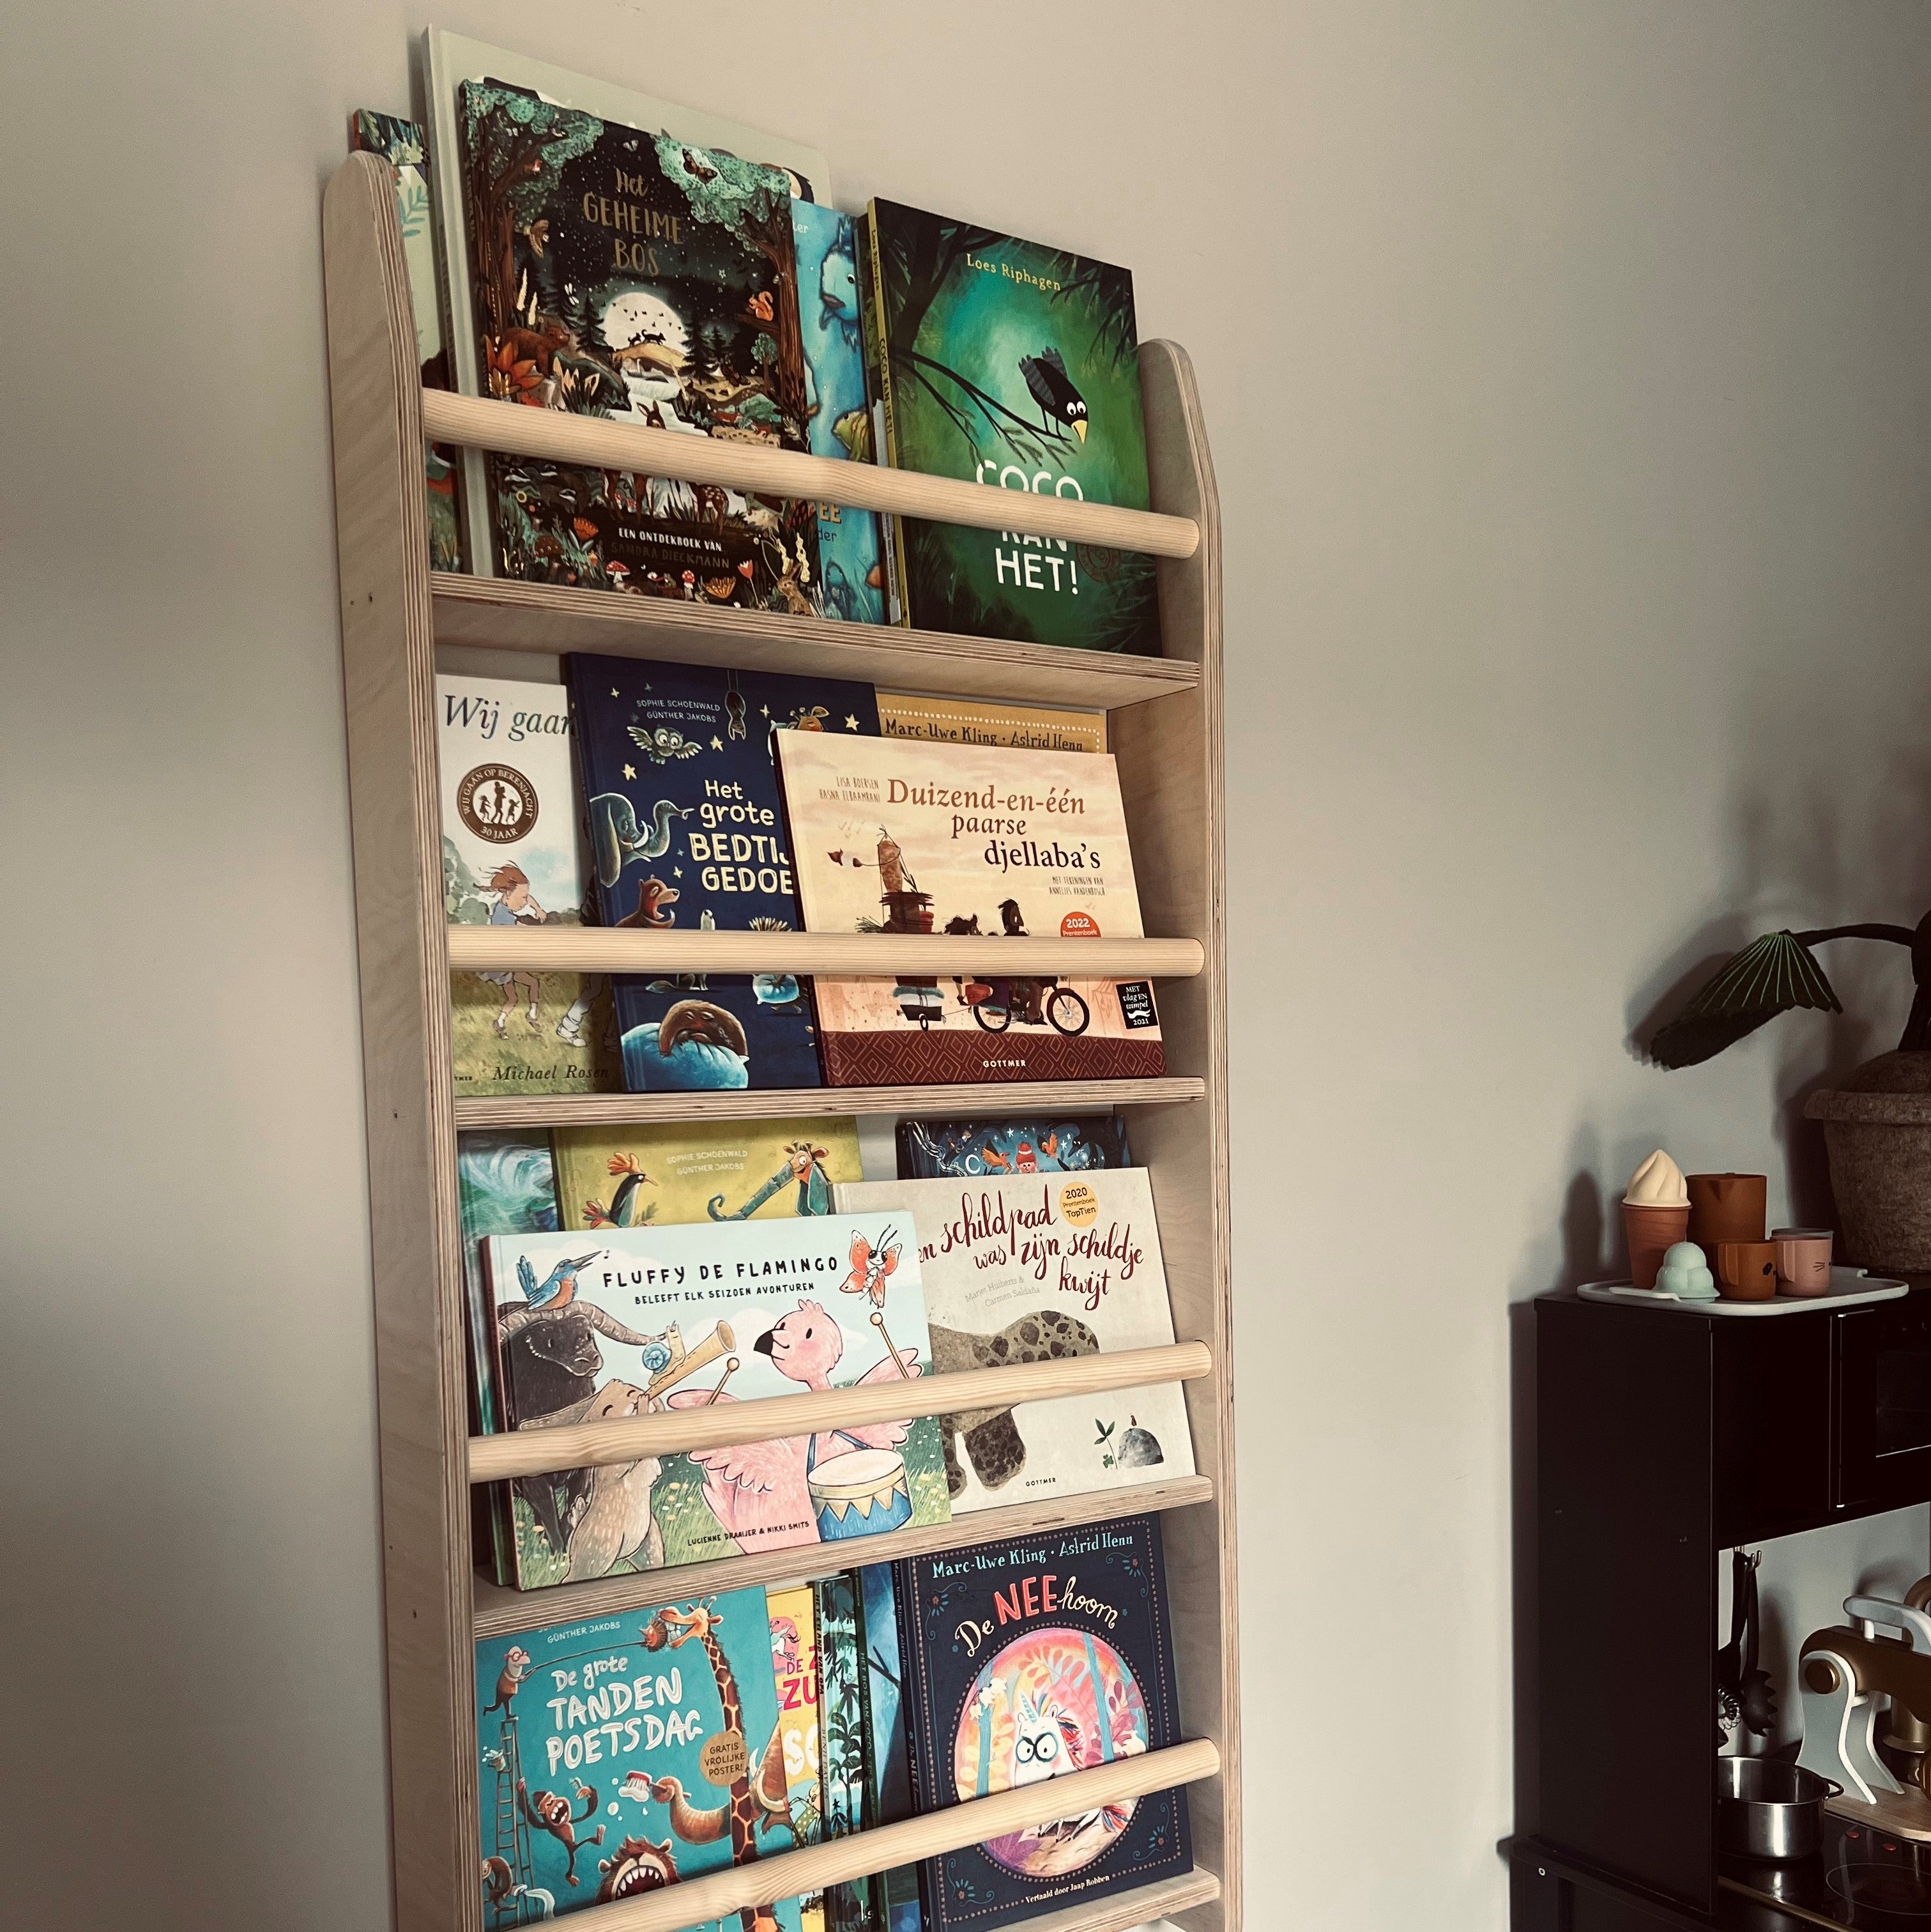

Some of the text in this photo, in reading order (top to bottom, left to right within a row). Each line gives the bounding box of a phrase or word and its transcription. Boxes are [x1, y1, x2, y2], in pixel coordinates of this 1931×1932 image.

[614, 167, 649, 197] Het
[583, 191, 685, 245] GEHEIME
[614, 238, 660, 276] BOS
[966, 253, 1061, 291] Loes Riphagen
[880, 338, 888, 373] COCO
[618, 527, 722, 552] EEN ONTDEKBOEK VAN
[611, 542, 729, 569] SANDRA DIECKMANN
[995, 548, 1079, 595] HET!
[445, 694, 500, 739] Wij
[667, 700, 721, 712] SCHOENWALD
[686, 712, 716, 723] JAKOBS
[885, 717, 957, 740] Marc-Uwe
[961, 726, 997, 746] Kling
[1011, 730, 1050, 749] Astrid
[464, 772, 484, 796] GAAN
[484, 768, 496, 778] OP
[498, 769, 534, 819] BERENJACHT
[705, 779, 744, 800] Het
[836, 776, 851, 787] LISA
[887, 779, 1085, 815] Duizend-en-één
[700, 801, 775, 829] grote
[950, 814, 1027, 839] paarse
[480, 826, 519, 839] 30 JAAR
[984, 839, 1101, 873] djellaba's
[701, 866, 793, 894] GEDOE
[1065, 917, 1090, 928] 2022
[492, 1064, 608, 1080] Michael Rosen
[982, 1059, 1026, 1068] GOTTMER
[666, 1150, 748, 1164] SOPHIE SCHOENWALD
[715, 1163, 744, 1171] JAKOBS
[1065, 1187, 1088, 1199] 2020
[940, 1184, 1058, 1255] schildpad
[1066, 1207, 1096, 1218] TopTien
[973, 1222, 1143, 1280] was zijn schildje
[603, 1257, 837, 1287] FLUFFY DE FLAMINGO
[1058, 1255, 1112, 1311] kwijt
[635, 1283, 814, 1305] BELEEFT ELK SEIZOEN AVONTUREN
[985, 1292, 1012, 1307] Carmen
[1026, 1477, 1056, 1487] GOTTMER
[687, 1535, 721, 1546] LUCIENNE
[767, 1525, 786, 1533] NIKKI
[788, 1521, 809, 1529] SMITS
[932, 1532, 1133, 1579] Marc-Uwe Kling Astrid Henn
[589, 1621, 621, 1633] JAKOBS
[955, 1620, 994, 1657] De
[551, 1655, 628, 1692] De grote
[786, 1659, 804, 1675] DE
[547, 1667, 682, 1731] TANDEN
[546, 1710, 703, 1777] POETSDAG
[710, 1742, 739, 1754] GRATIS
[705, 1752, 745, 1767] VROLIJKE
[709, 1763, 744, 1776] POSTER!
[1025, 1875, 1110, 1903] Vertaald door Jaap Robben
